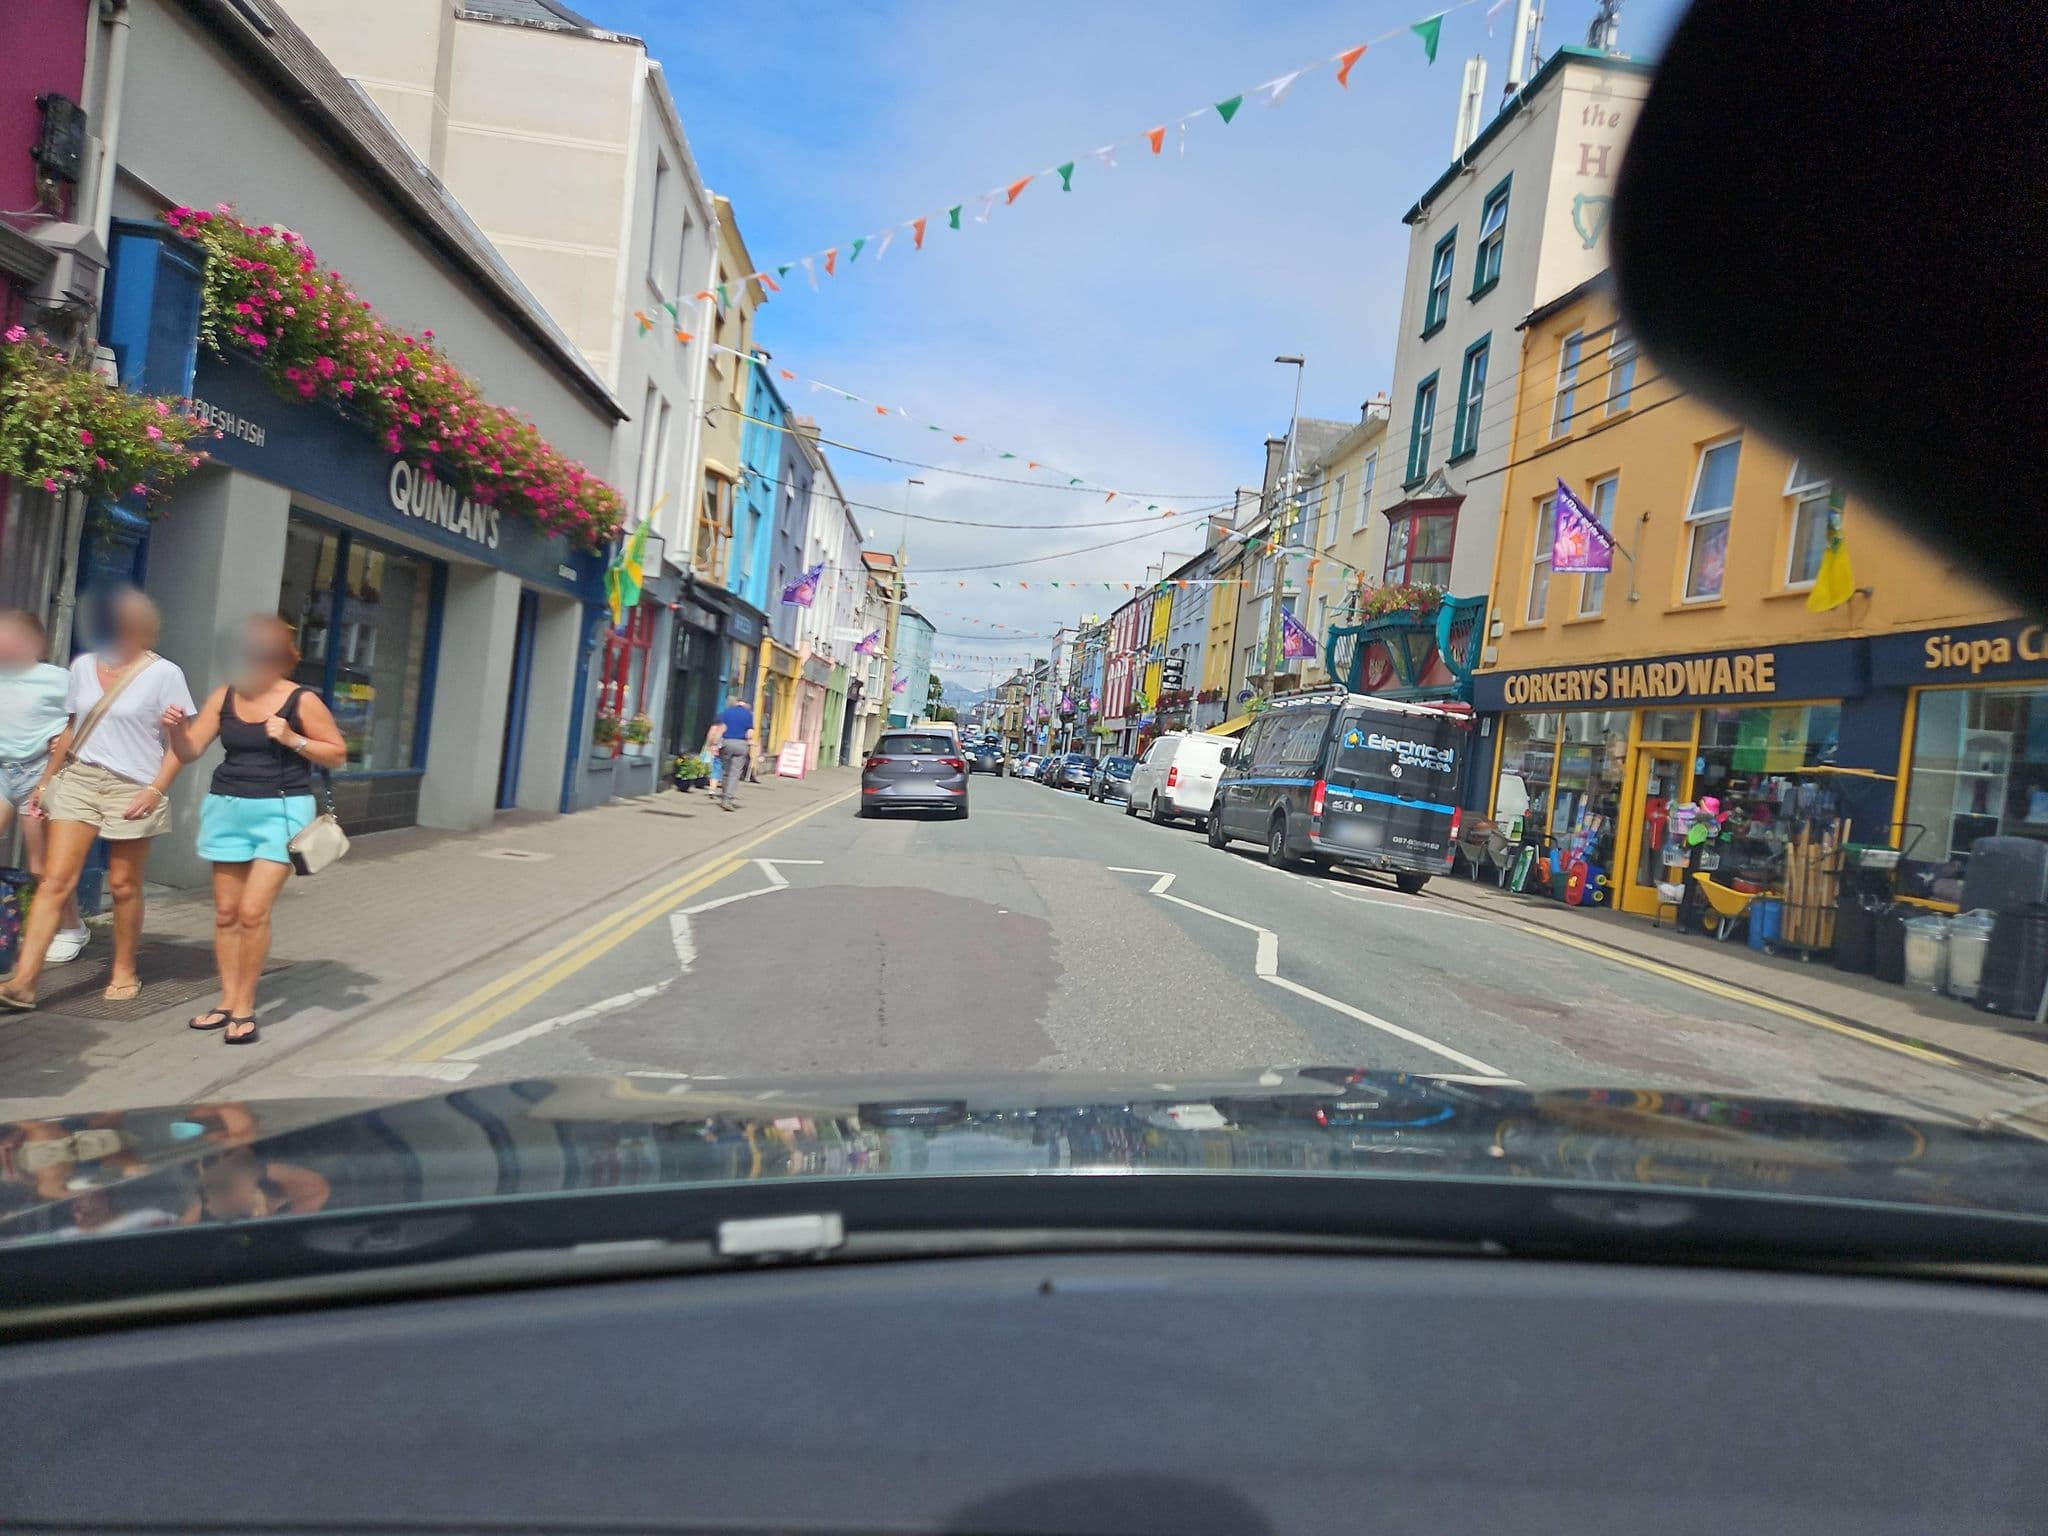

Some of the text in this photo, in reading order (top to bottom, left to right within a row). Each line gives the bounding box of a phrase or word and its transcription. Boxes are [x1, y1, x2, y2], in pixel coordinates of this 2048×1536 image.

[1583, 104, 1621, 128] the
[1577, 143, 1613, 178] H
[194, 398, 266, 448] FRESH FISH
[389, 460, 500, 549] QUINLAN'S
[1924, 624, 2048, 674] Siopa C
[1504, 652, 1776, 704] CORKERYS HARDWARE
[1367, 733, 1455, 764] Electrical
